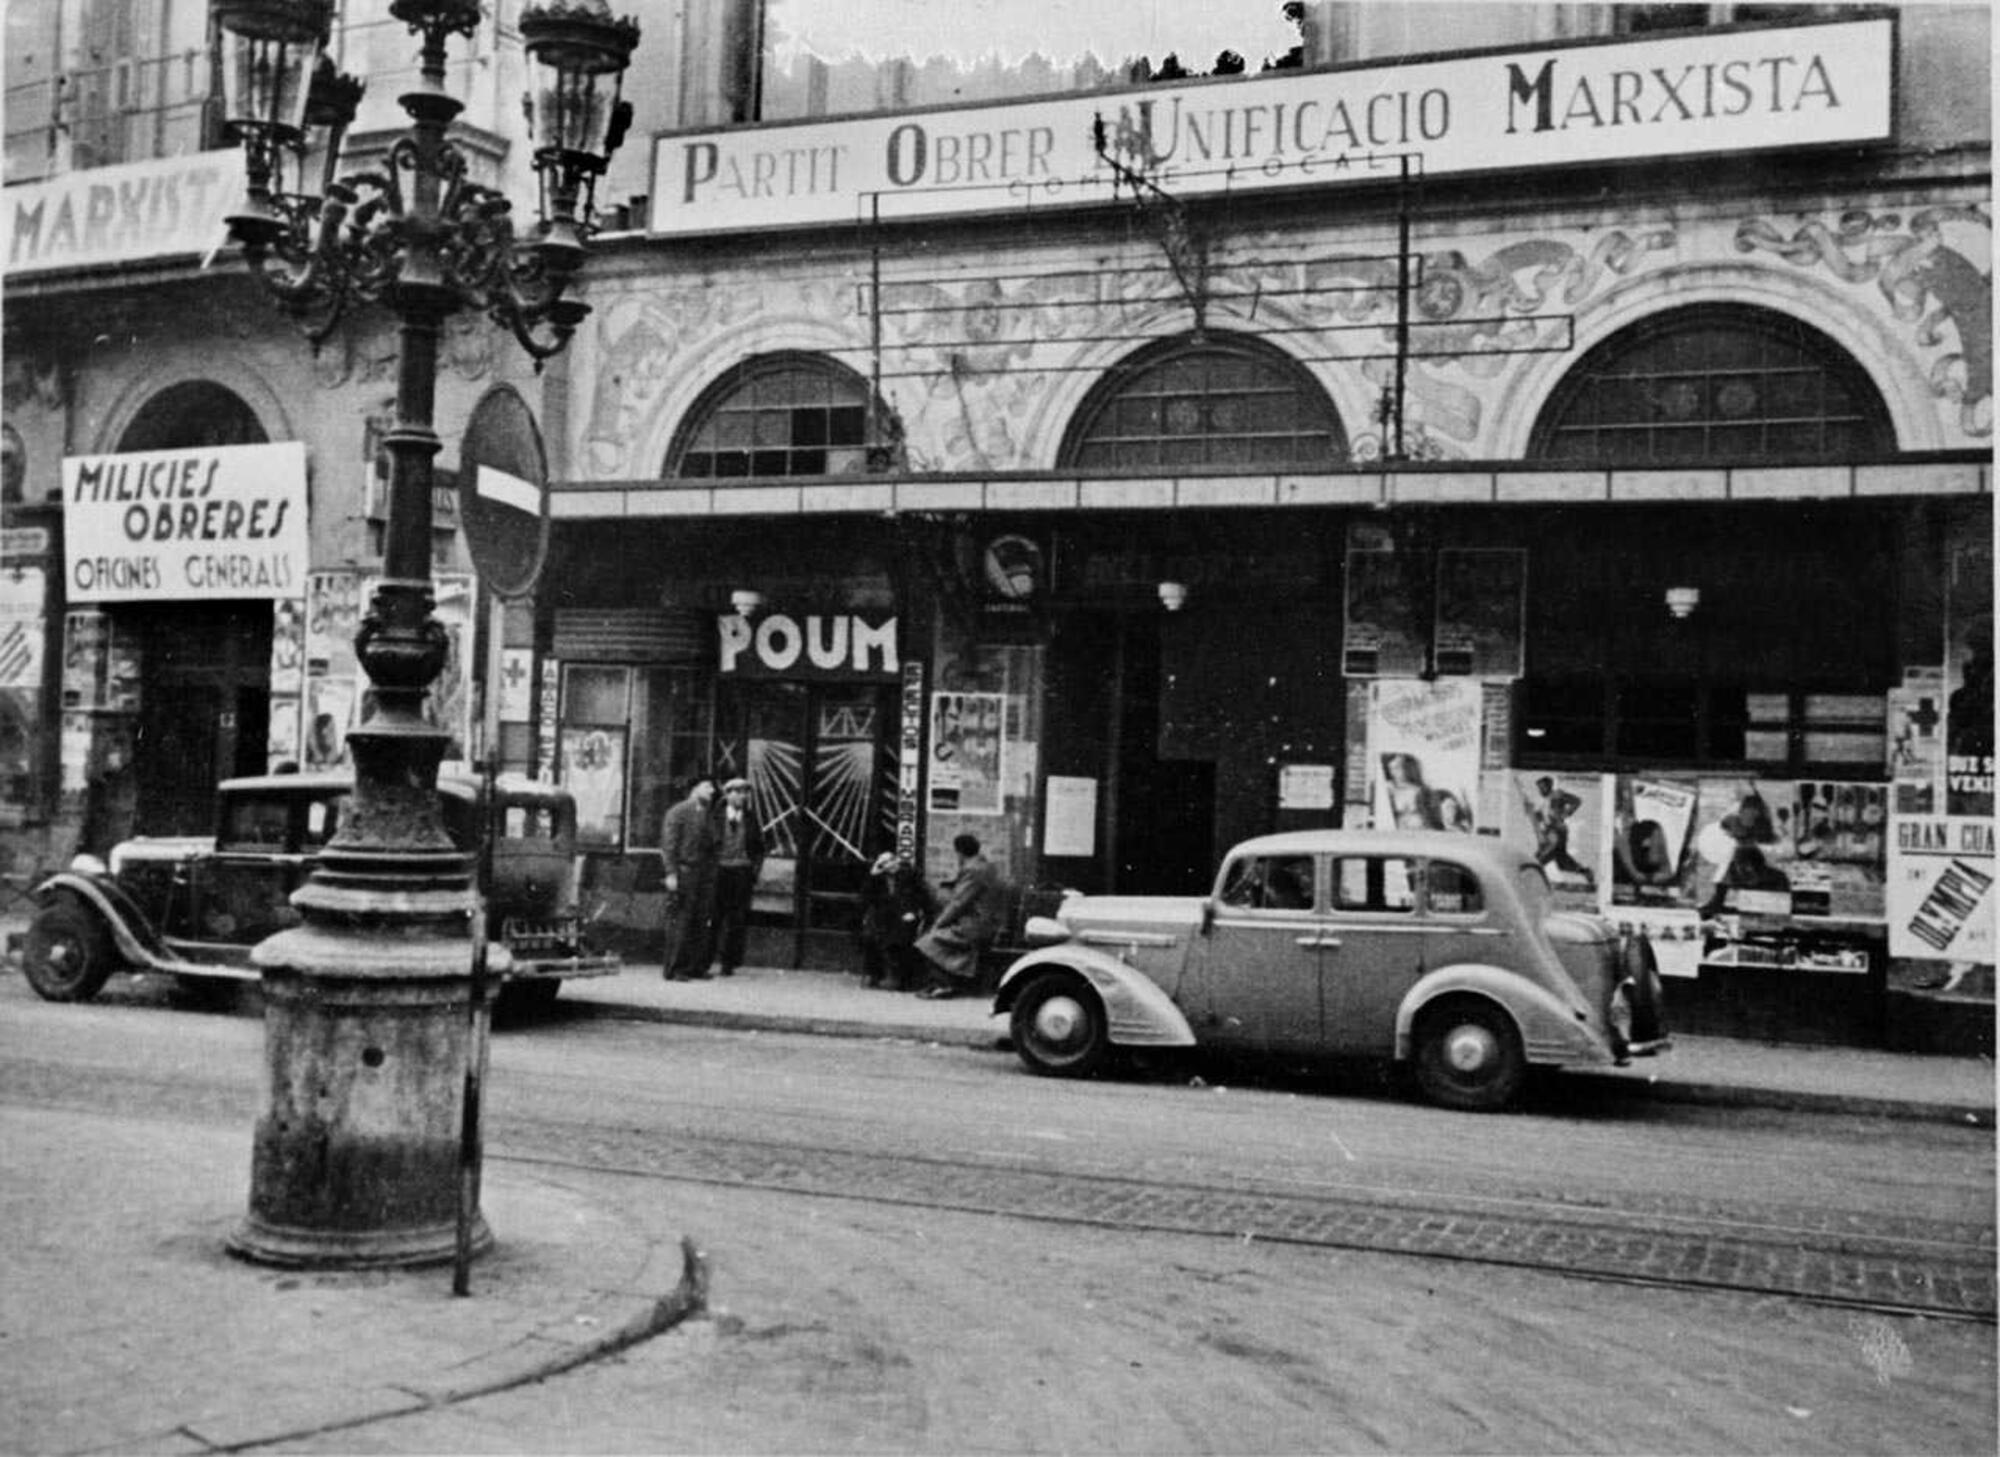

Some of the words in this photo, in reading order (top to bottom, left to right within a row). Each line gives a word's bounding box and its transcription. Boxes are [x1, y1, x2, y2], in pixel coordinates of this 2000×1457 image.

[682, 140, 848, 204] PARTIT
[887, 123, 1054, 186] OBRER
[1504, 54, 1841, 134] MARXISTA
[74, 458, 220, 503] MILICIES
[123, 497, 290, 541] OBRERES
[74, 556, 162, 590] OFICINES
[184, 554, 292, 588] GENERALS
[718, 614, 899, 673] POUM
[897, 764, 918, 862] TIMBRADO
[1898, 821, 1948, 849] GRAN
